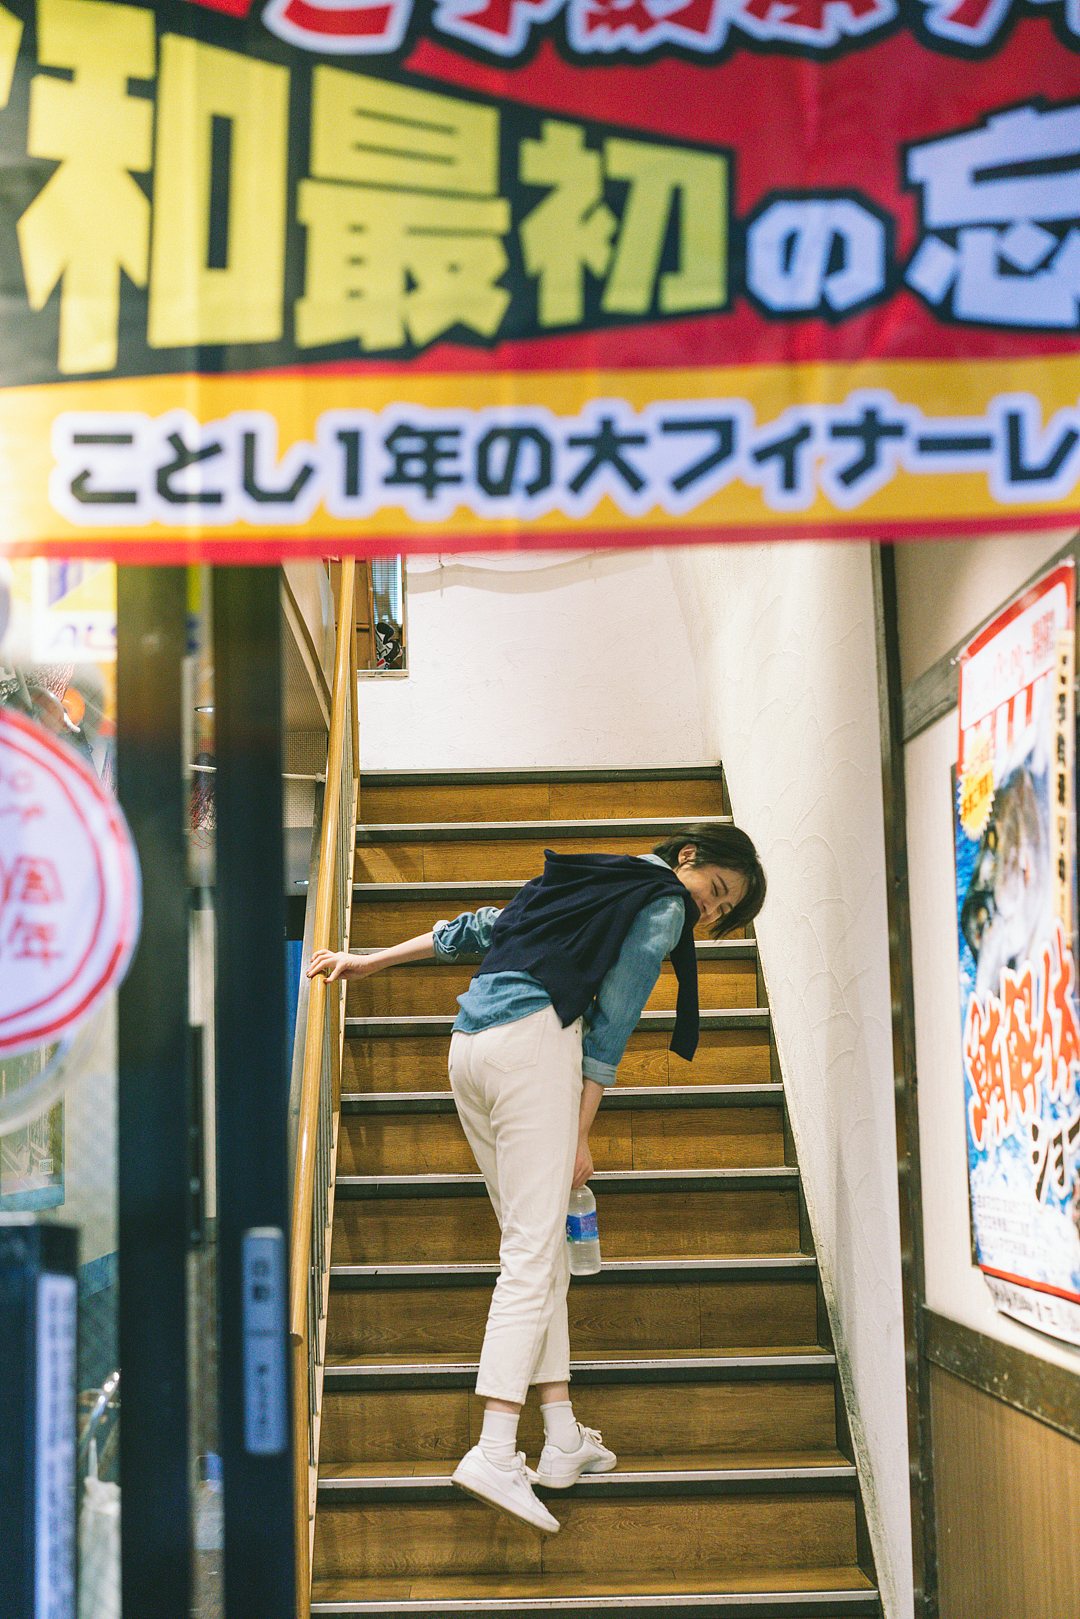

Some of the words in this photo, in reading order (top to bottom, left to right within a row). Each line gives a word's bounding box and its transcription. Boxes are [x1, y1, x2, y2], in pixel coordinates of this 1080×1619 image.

[0, 0, 1080, 374] 和最初の忘
[70, 407, 1079, 505] ことし1年の大フィナーレ
